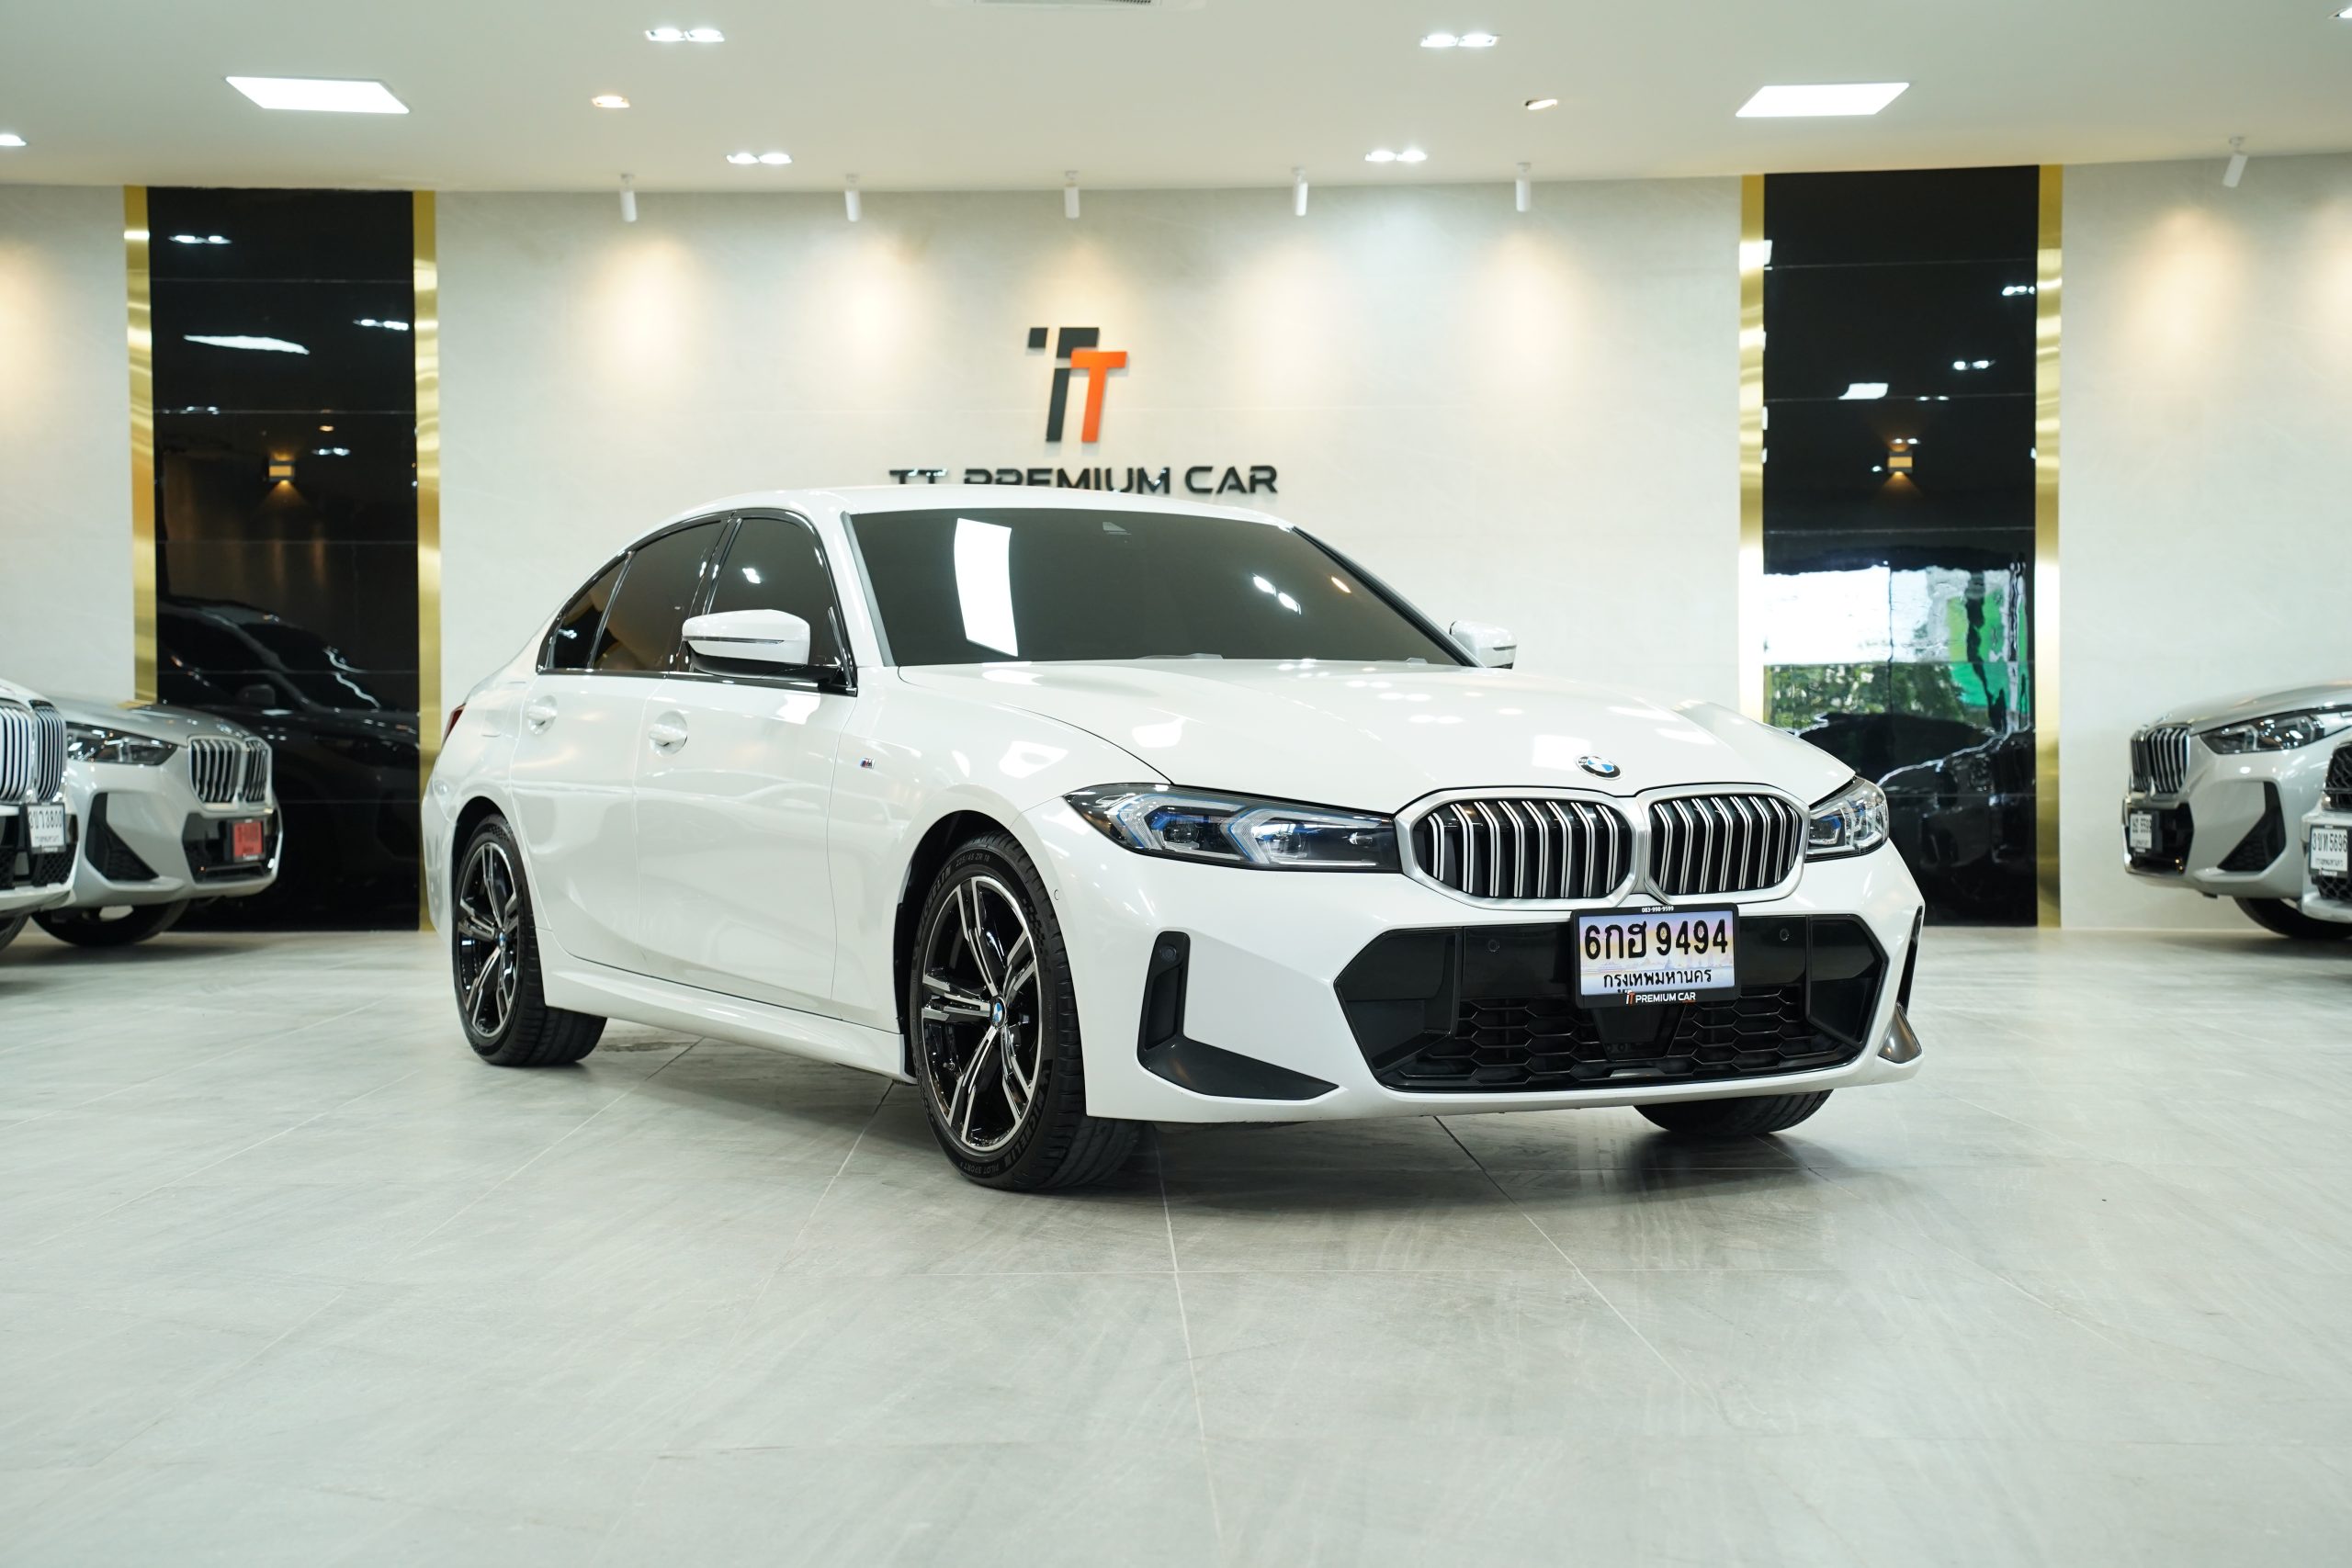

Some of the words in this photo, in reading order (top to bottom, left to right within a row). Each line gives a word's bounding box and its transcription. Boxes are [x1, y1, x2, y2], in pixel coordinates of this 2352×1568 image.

[1184, 465, 1278, 494] CAR
[1656, 919, 1728, 956] 9494
[1603, 969, 1712, 992] กรุงเทพมหานคร
[1635, 992, 1677, 1003] PREMIUM
[1678, 991, 1696, 1001] CAR
